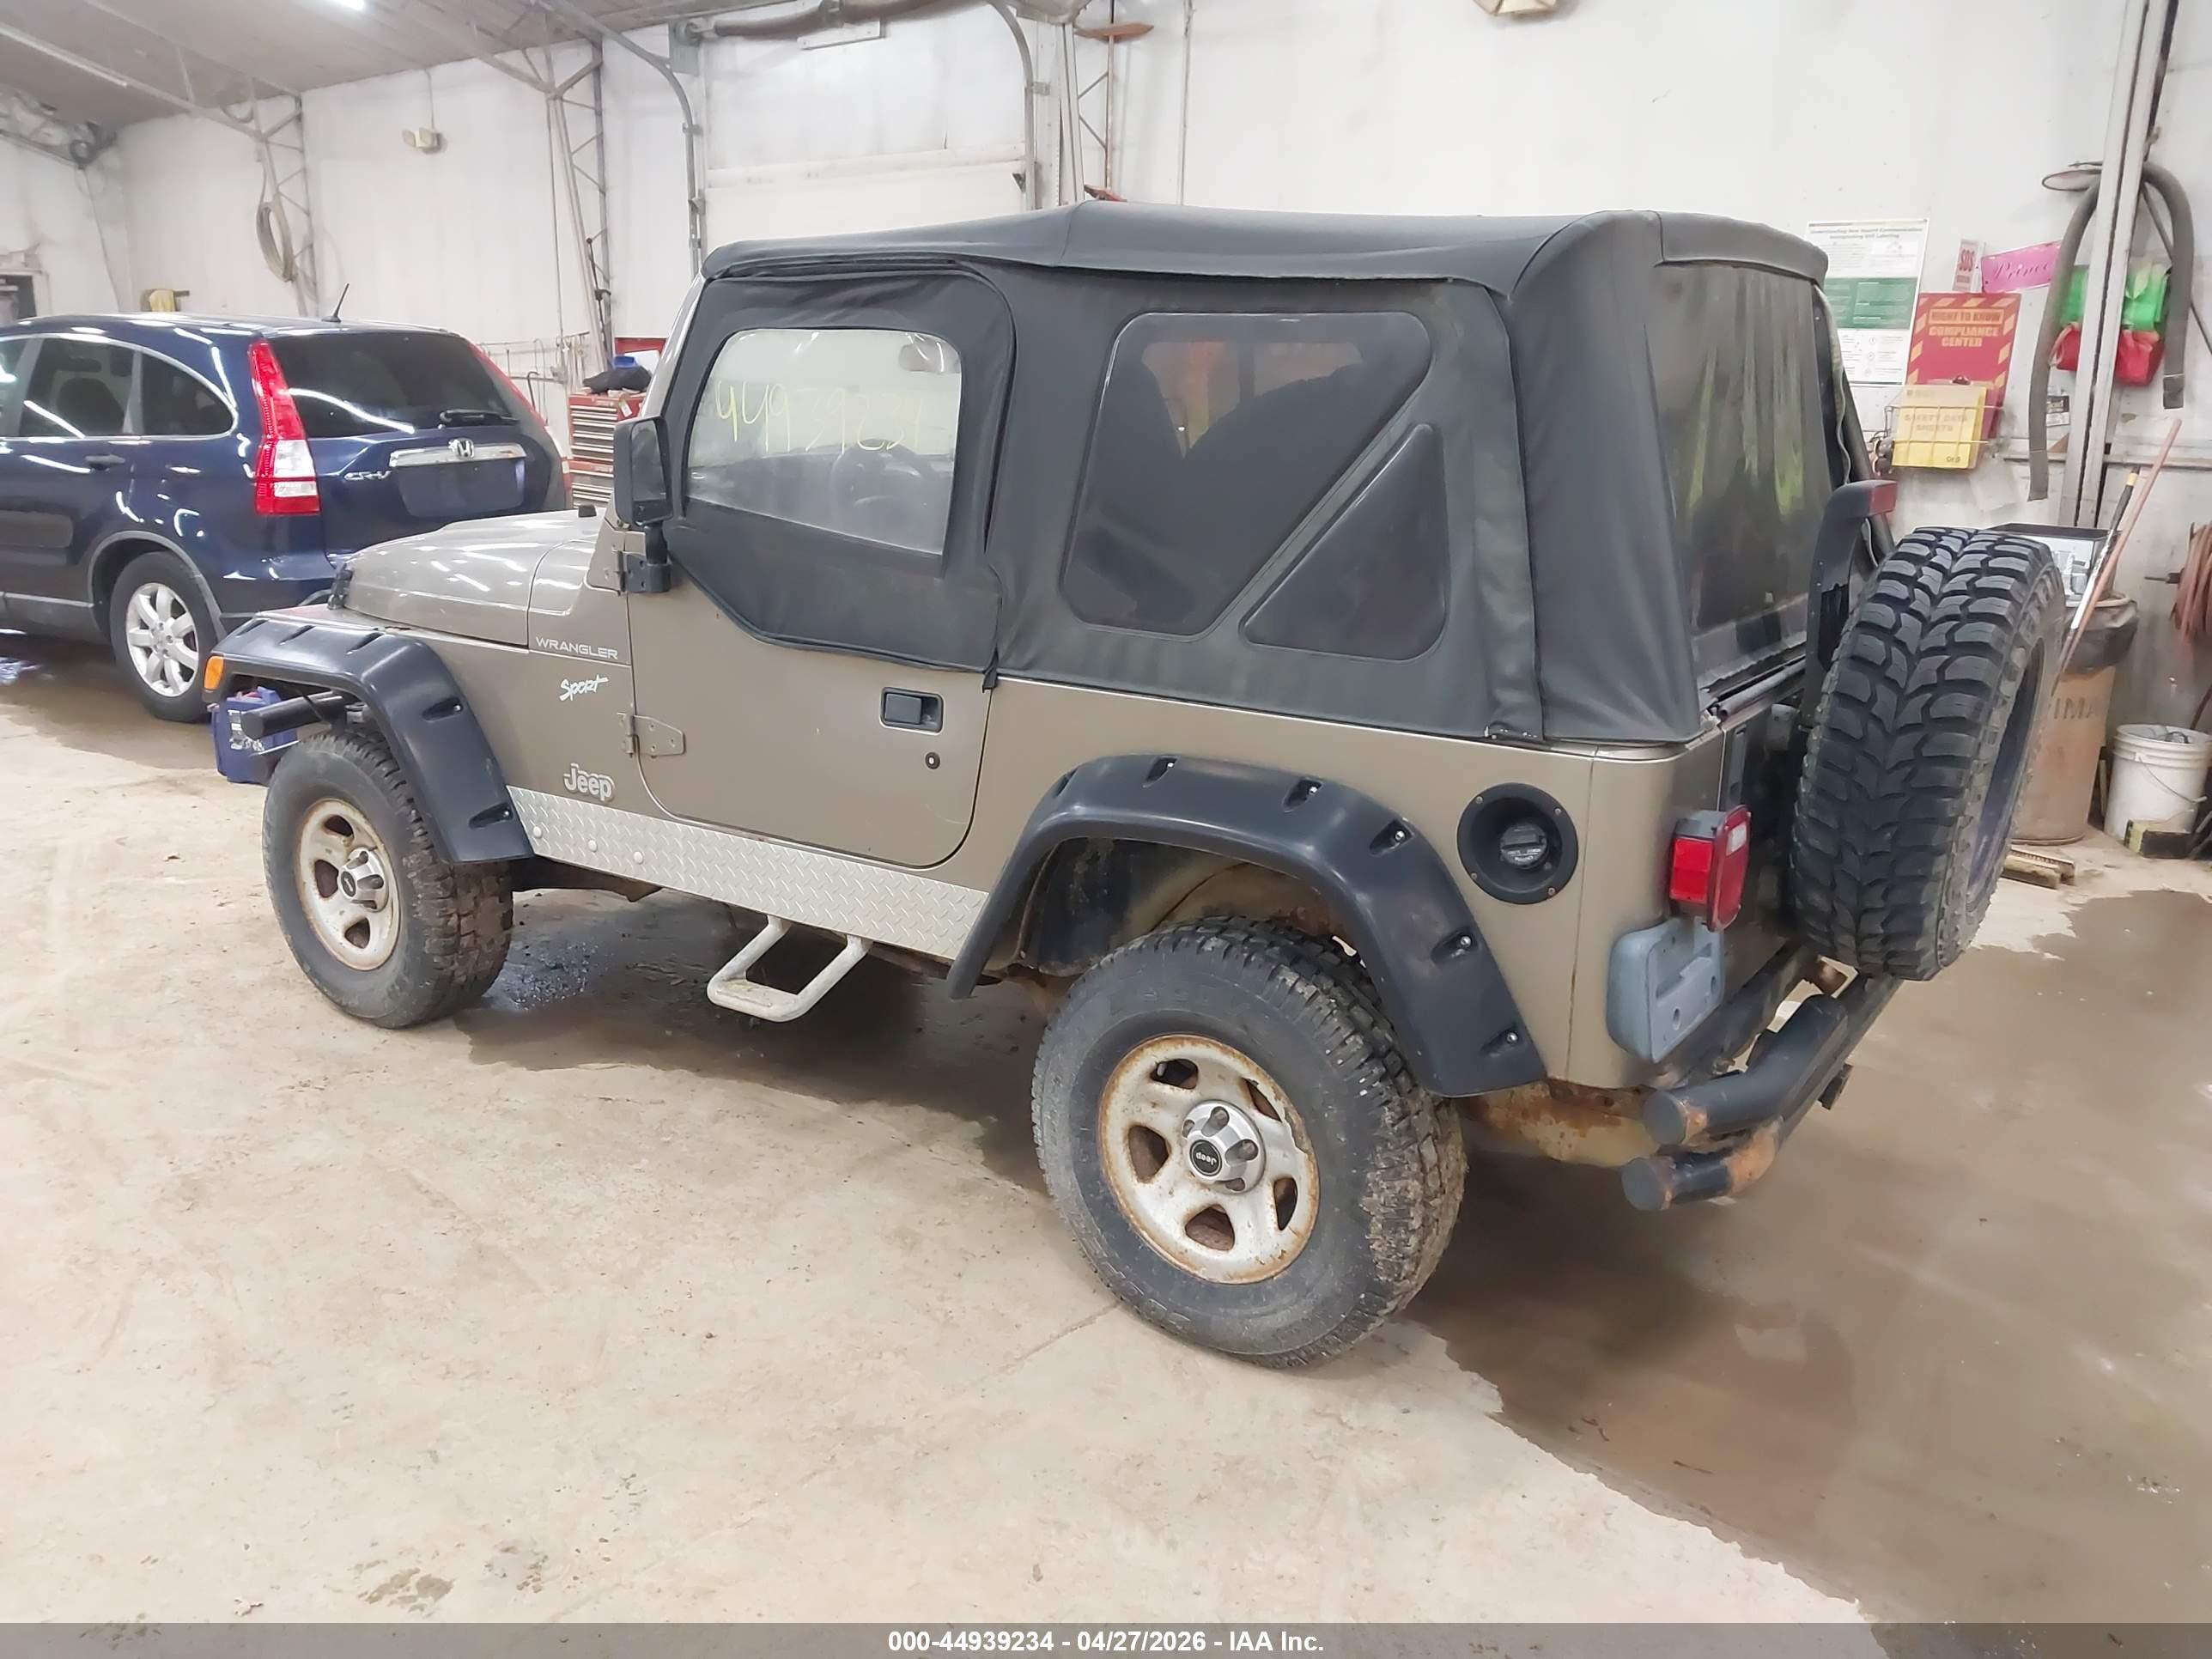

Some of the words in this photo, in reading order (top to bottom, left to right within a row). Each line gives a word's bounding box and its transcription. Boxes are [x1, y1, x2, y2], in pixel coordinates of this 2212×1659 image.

[1929, 326, 1999, 337] COMPLIANCE
[1942, 337, 1983, 347] CENTER
[535, 636, 619, 659] WRANGLER
[563, 763, 615, 801] Jeep
